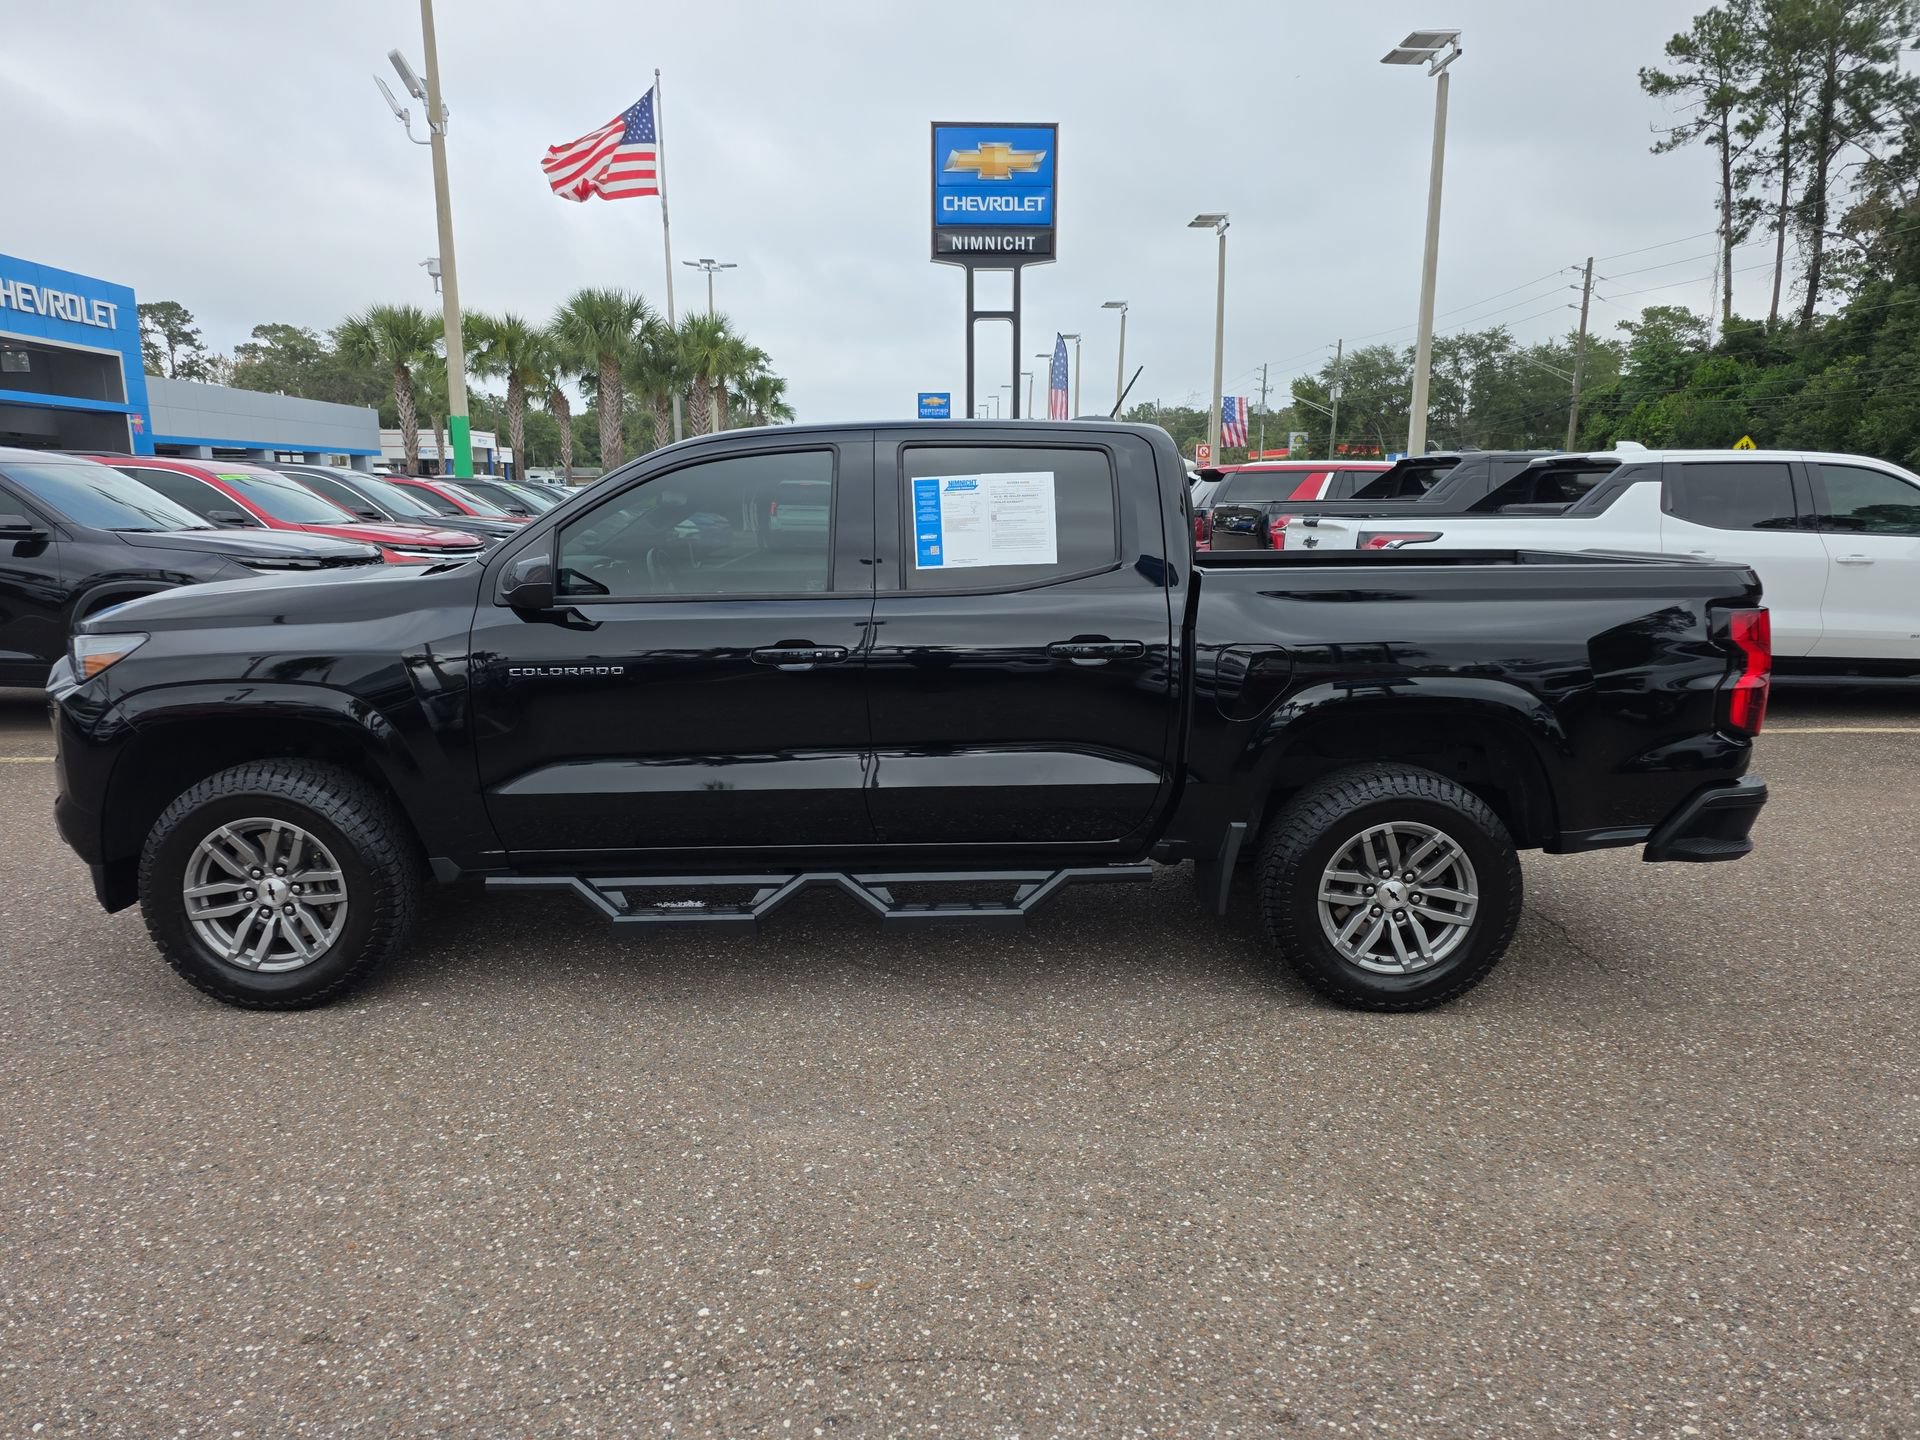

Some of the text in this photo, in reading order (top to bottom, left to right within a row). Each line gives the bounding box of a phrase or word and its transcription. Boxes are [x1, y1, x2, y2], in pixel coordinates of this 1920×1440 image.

[943, 196, 1046, 212] CHEVROLET
[952, 236, 1036, 251] NIMNICHT
[0, 277, 118, 330] HEVROLET
[508, 666, 625, 677] COLORADO
